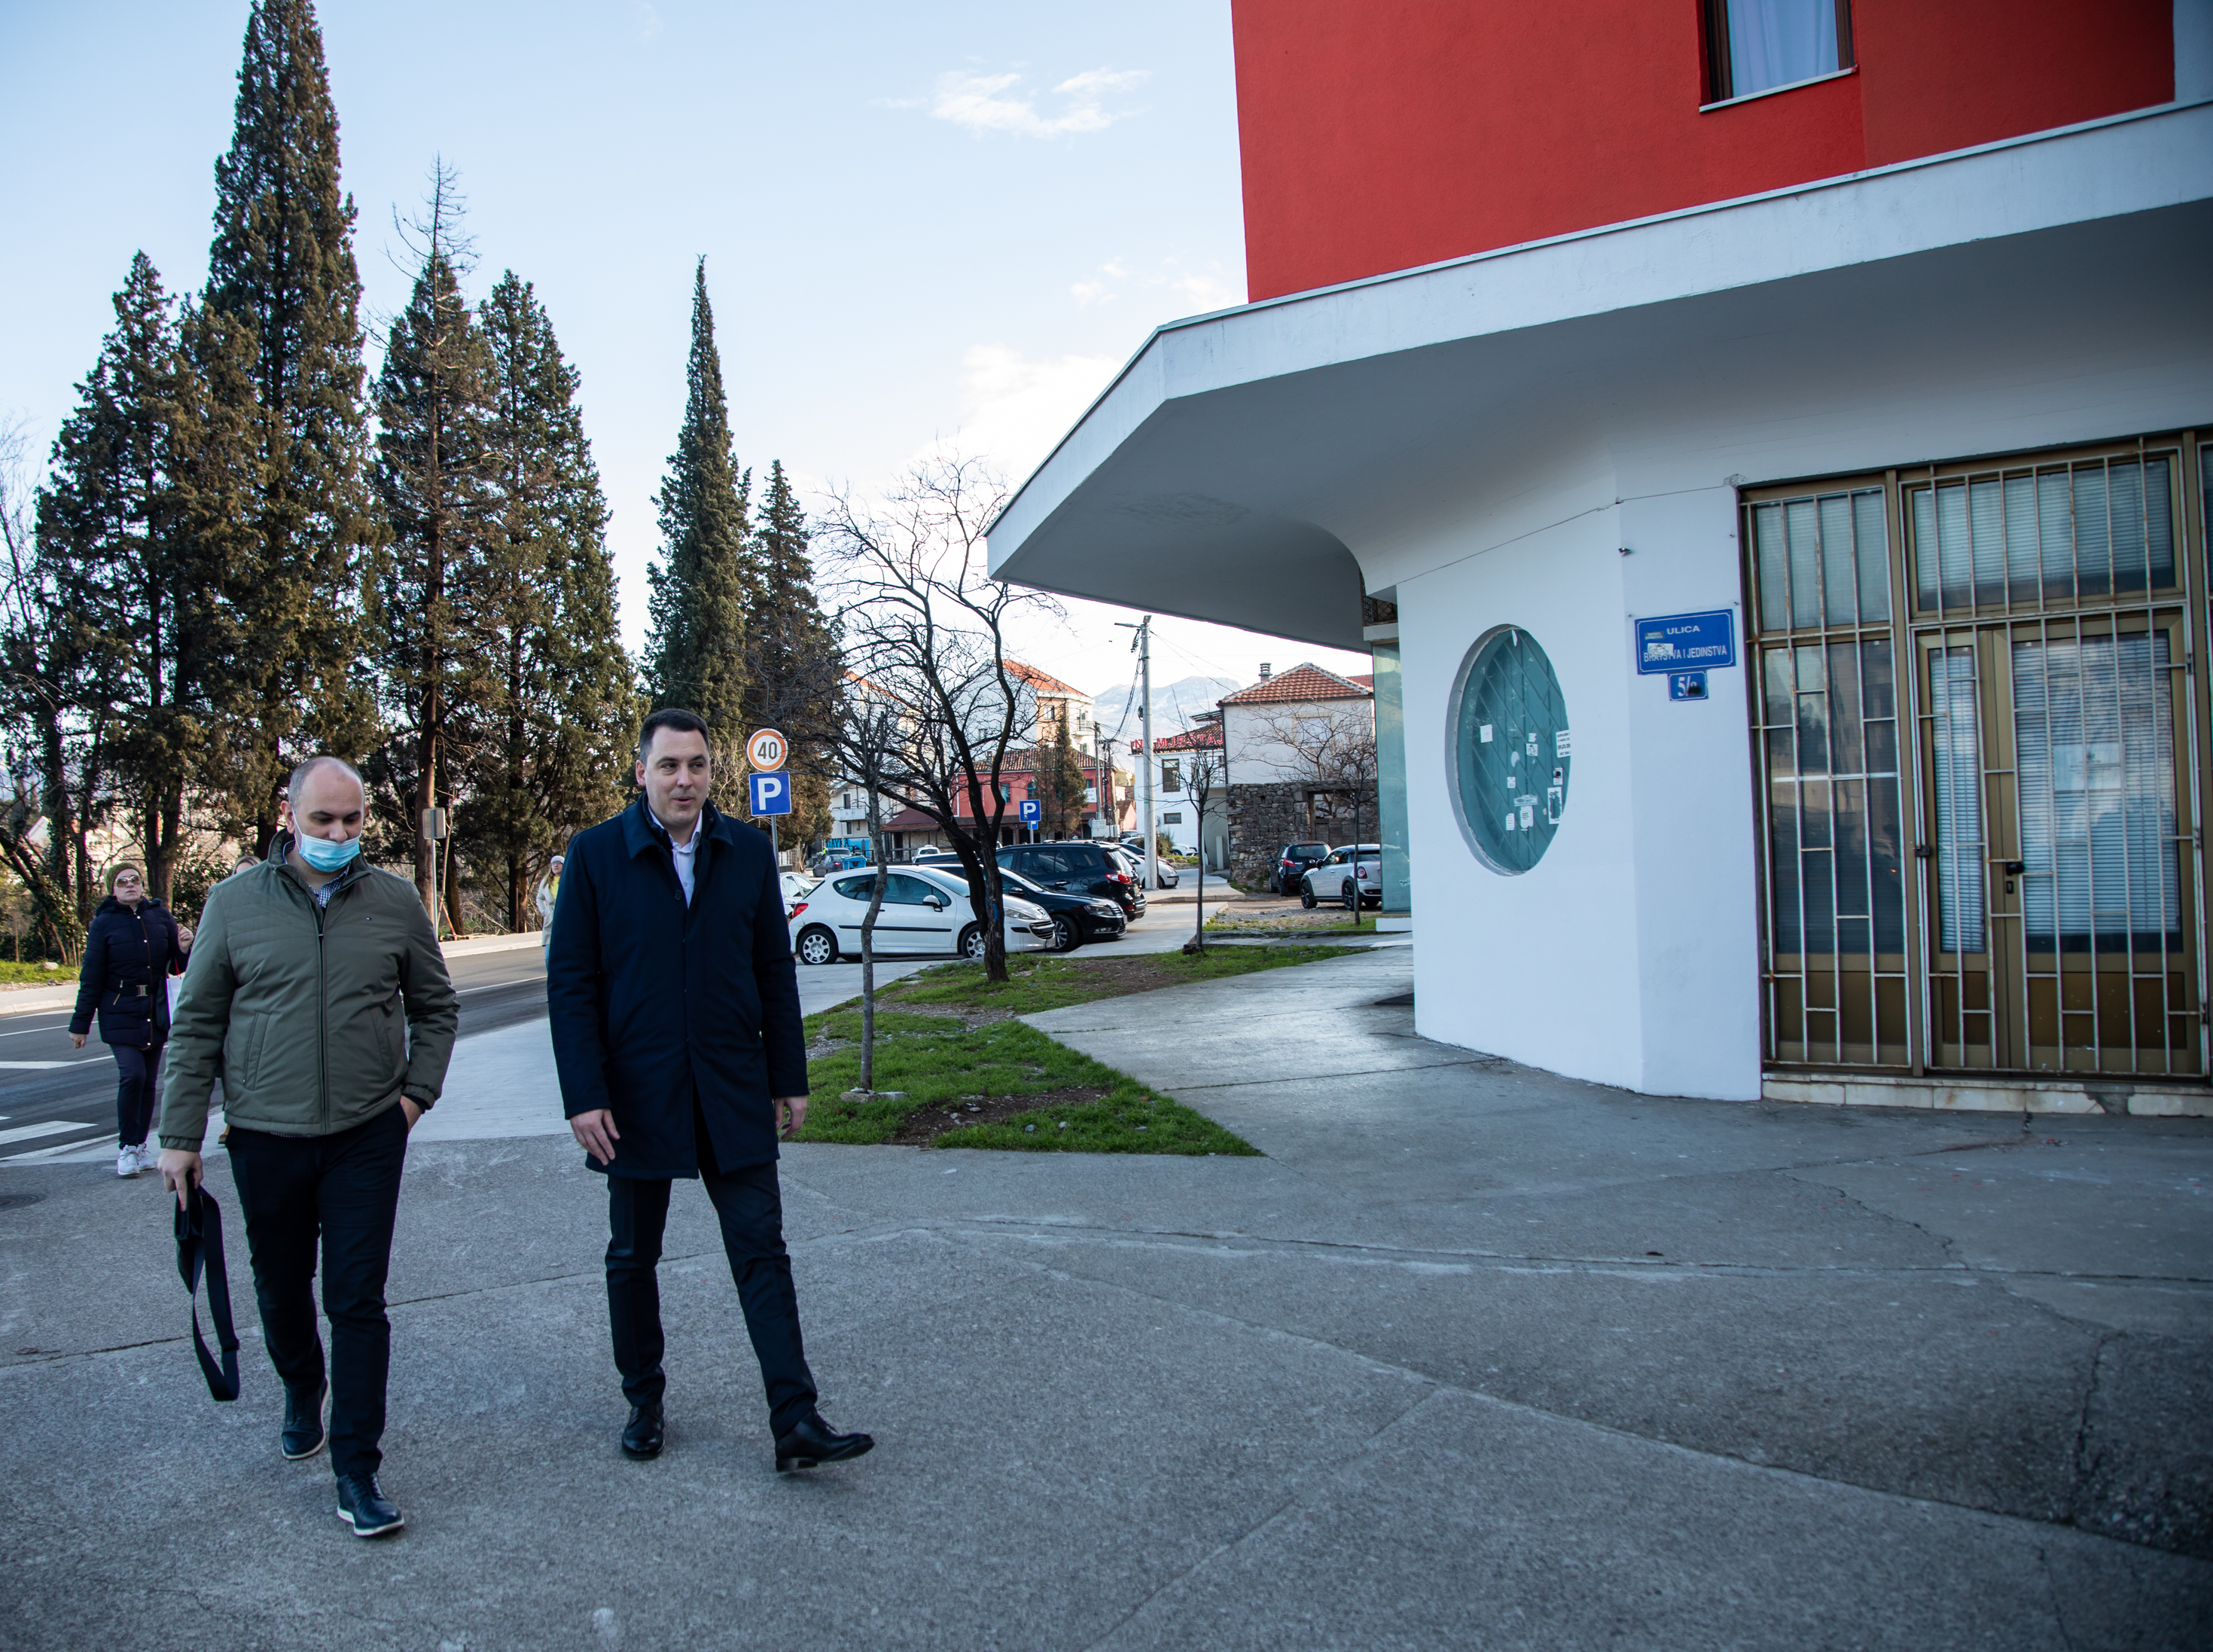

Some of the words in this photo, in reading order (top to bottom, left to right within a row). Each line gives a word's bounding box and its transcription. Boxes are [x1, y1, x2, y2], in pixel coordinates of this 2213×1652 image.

[1666, 625, 1700, 635] ULICA
[1683, 648, 1686, 659] I
[1687, 645, 1727, 659] JEDINSTVA
[1135, 732, 1224, 749] NMJEŠTAJ
[757, 742, 777, 760] 40
[757, 777, 782, 810] P
[1023, 803, 1036, 819] P
